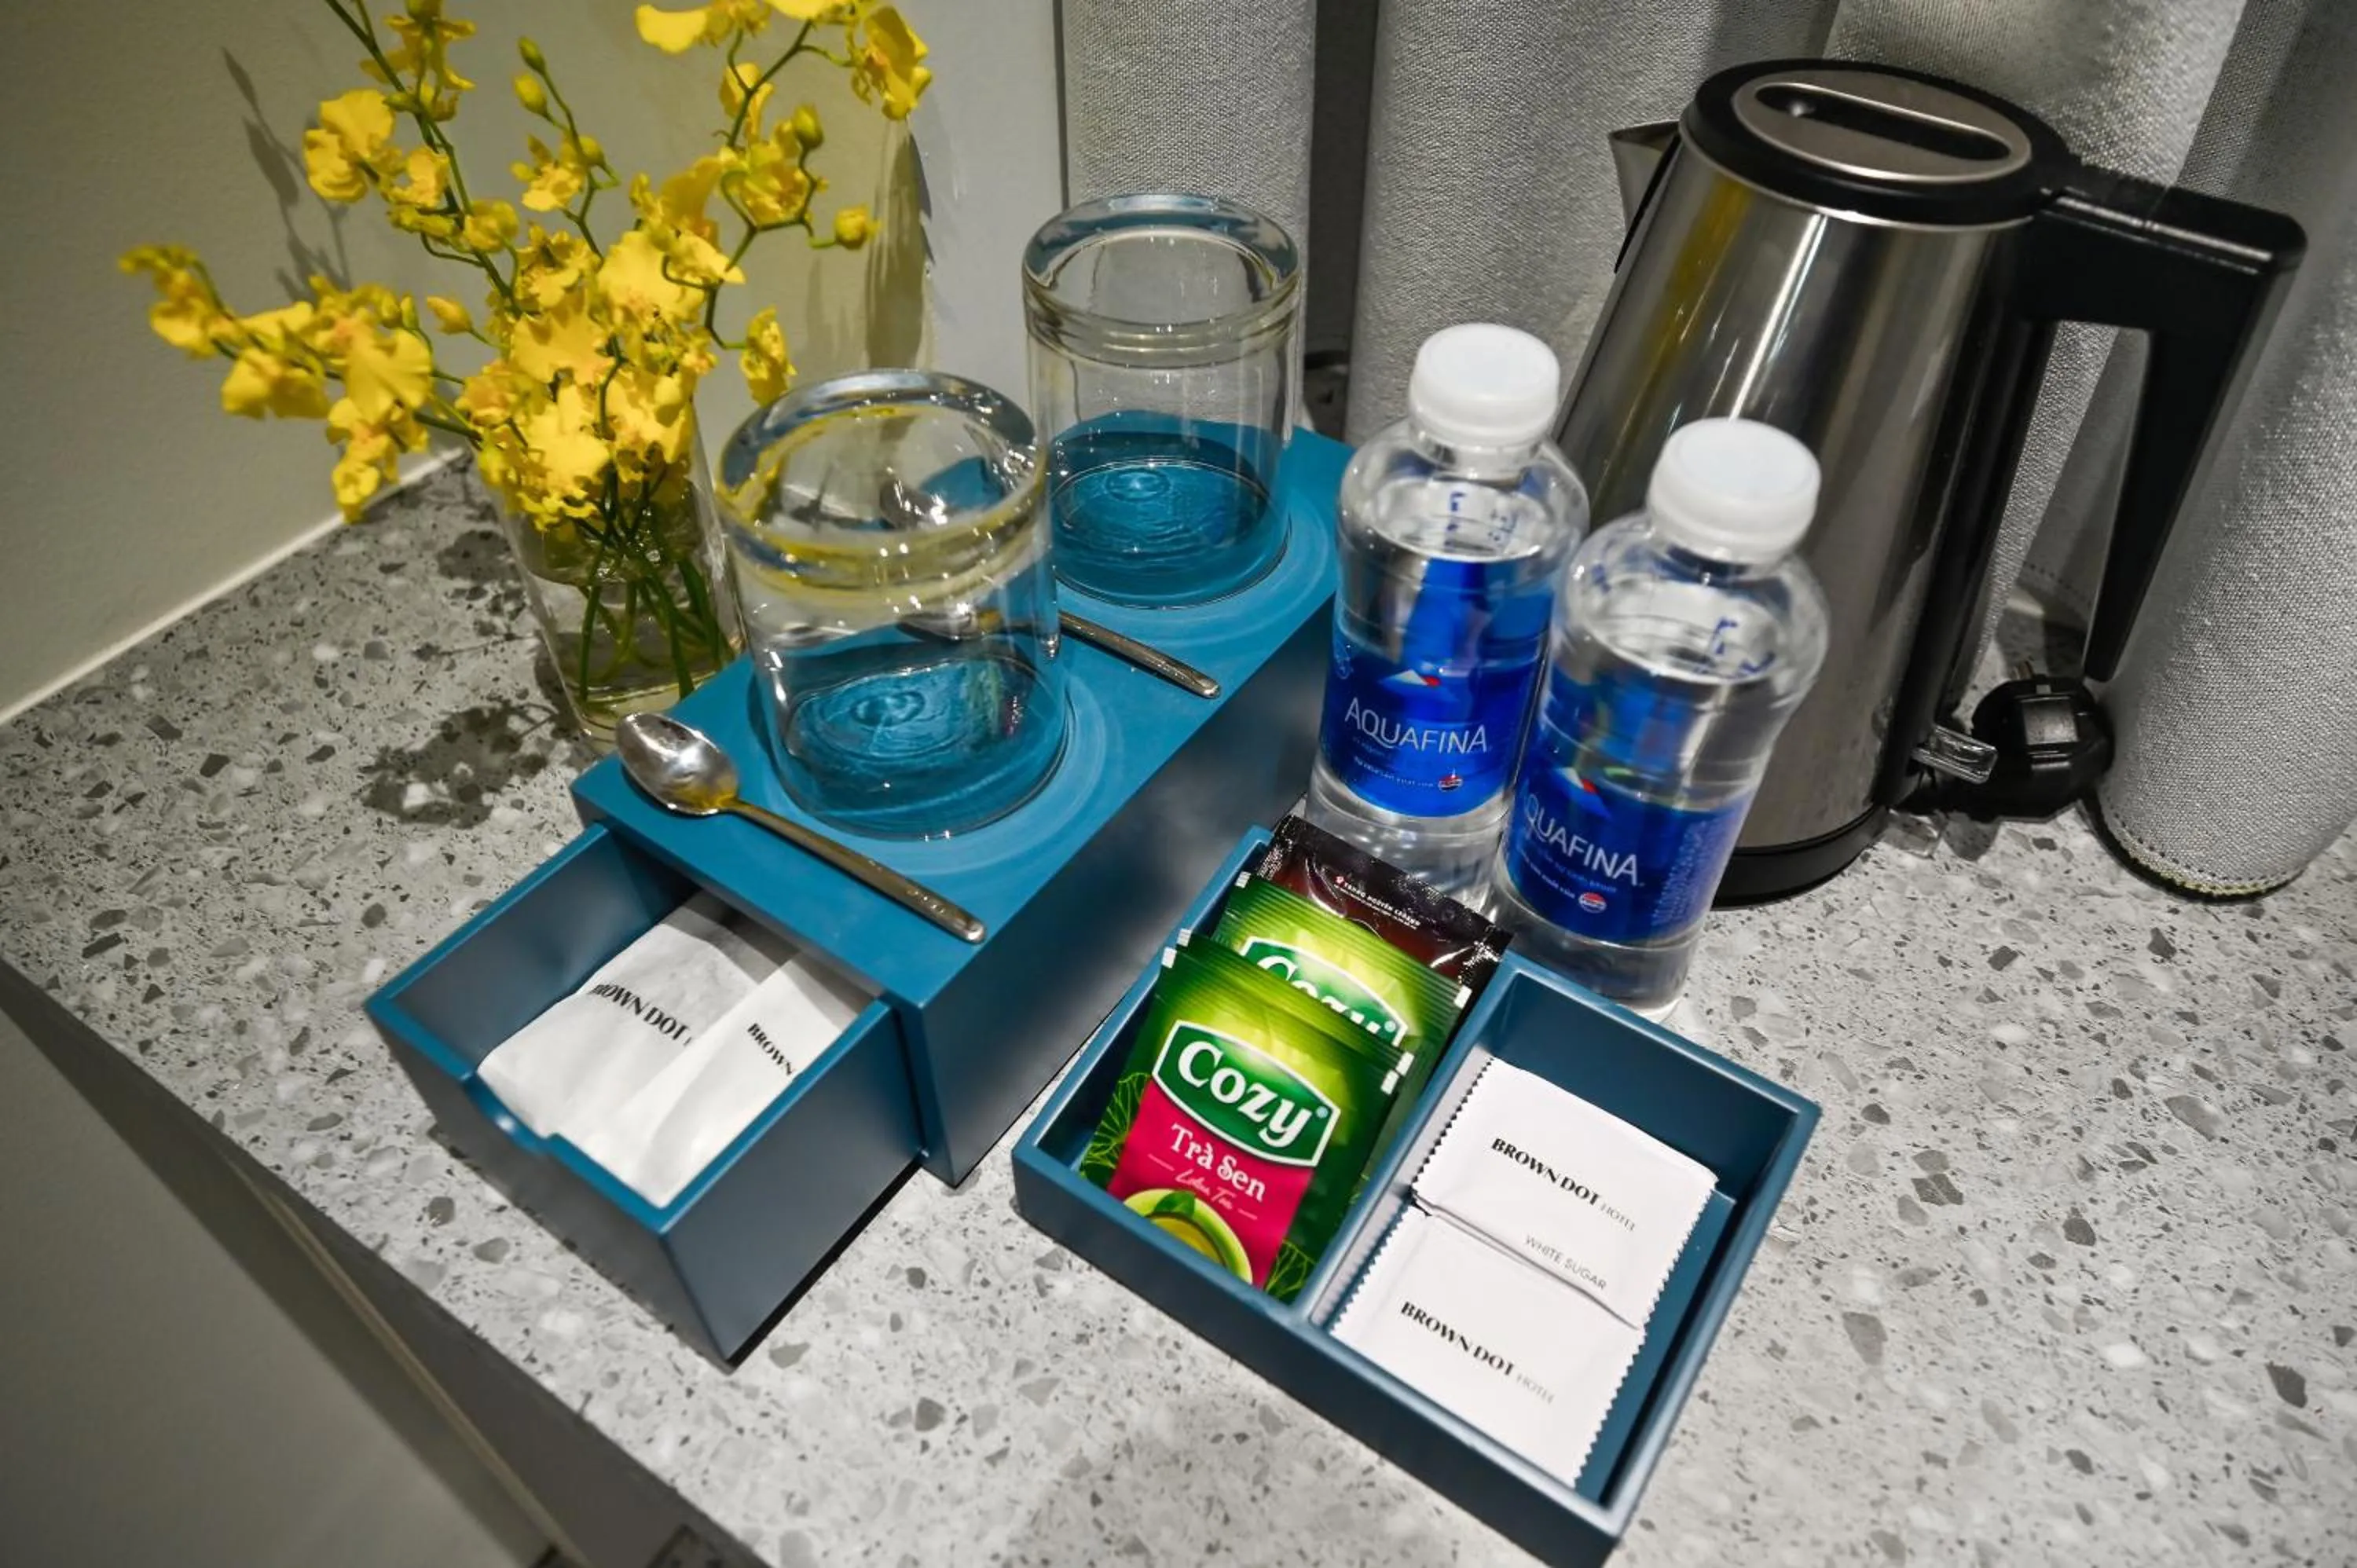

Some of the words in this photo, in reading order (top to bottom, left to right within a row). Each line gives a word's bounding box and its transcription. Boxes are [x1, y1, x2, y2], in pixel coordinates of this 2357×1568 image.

[1344, 697, 1488, 755] AQUAFINA
[1523, 793, 1640, 887] QUAFINA
[643, 1006, 691, 1041] DOT
[747, 1023, 796, 1076] BROWN
[1178, 1041, 1313, 1148] Cozy
[1171, 1123, 1215, 1170] Trà
[1216, 1155, 1266, 1203] Sen
[1491, 1138, 1560, 1184] BROWN
[1560, 1176, 1600, 1206] DOT
[1524, 1234, 1564, 1265] WHITE
[1564, 1258, 1608, 1291] SUGAR
[1400, 1301, 1473, 1353] BROWN
[1472, 1345, 1515, 1376] DOT
